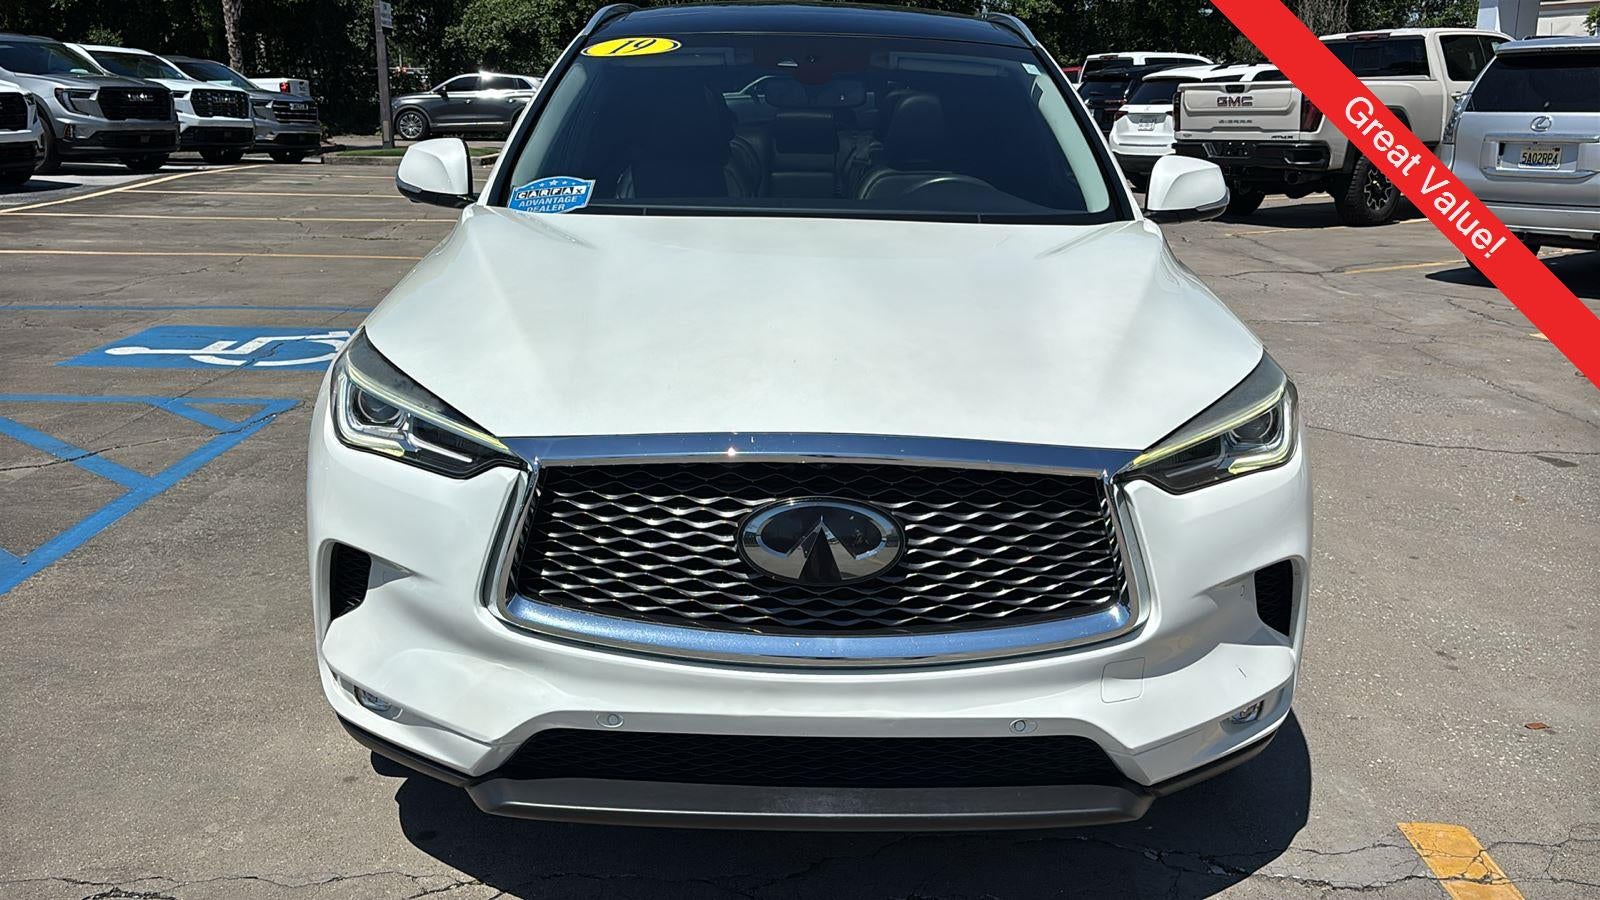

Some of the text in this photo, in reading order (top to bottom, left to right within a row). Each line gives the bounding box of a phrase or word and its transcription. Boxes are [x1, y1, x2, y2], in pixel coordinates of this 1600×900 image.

[1216, 96, 1253, 107] GMC
[516, 186, 586, 200] CARFAX
[518, 196, 577, 208] ADVANTAGE
[526, 204, 566, 213] DEALER
